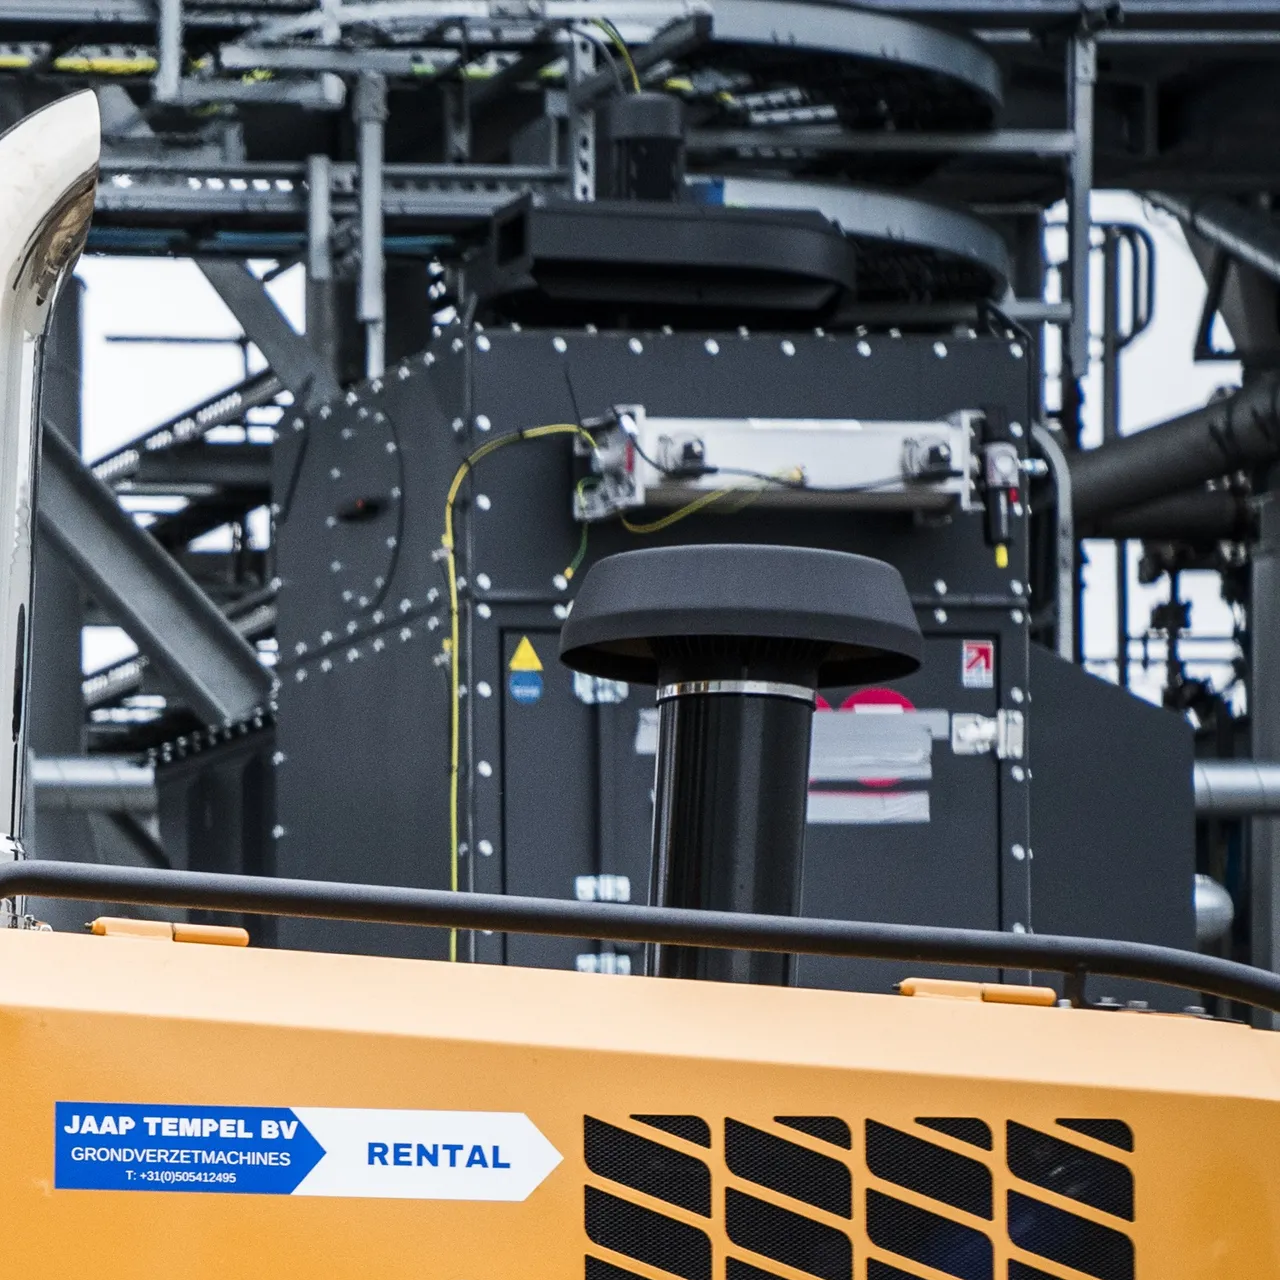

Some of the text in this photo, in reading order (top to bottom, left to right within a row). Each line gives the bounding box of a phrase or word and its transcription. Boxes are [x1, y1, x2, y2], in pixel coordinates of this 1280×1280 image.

[63, 1114, 299, 1141] JAAP TEMPEL BV
[70, 1147, 292, 1167] GRONDVERZETMACHINES
[366, 1142, 511, 1169] RENTAL
[125, 1170, 237, 1184] T: +31(0)505412495
